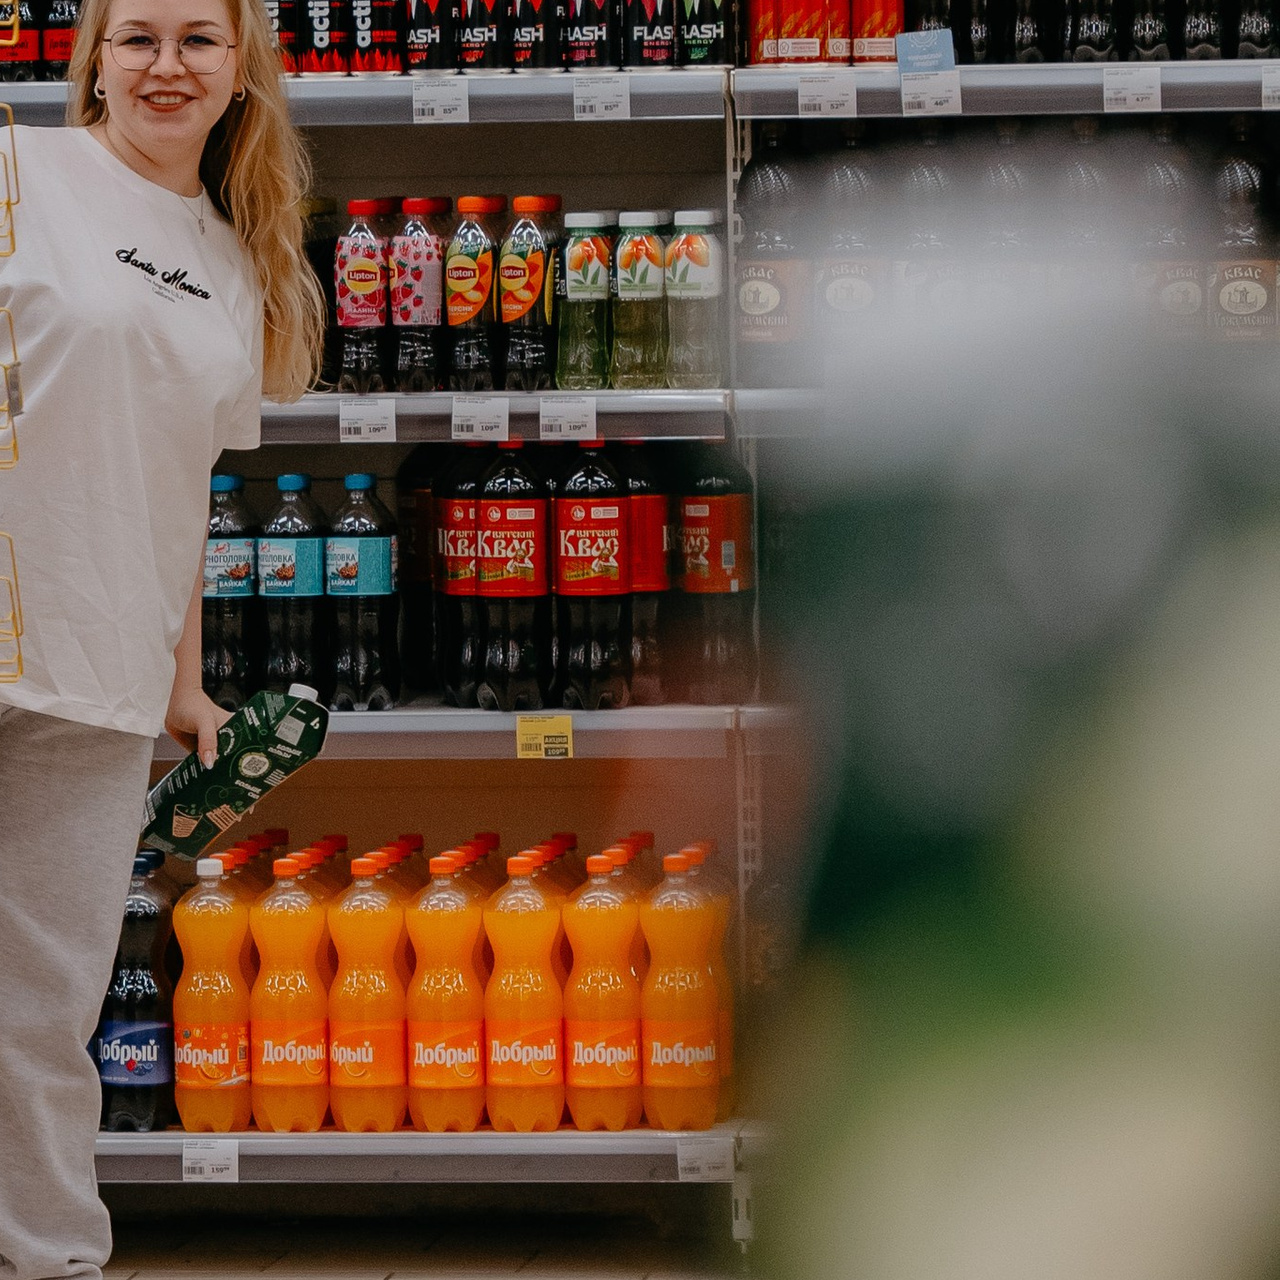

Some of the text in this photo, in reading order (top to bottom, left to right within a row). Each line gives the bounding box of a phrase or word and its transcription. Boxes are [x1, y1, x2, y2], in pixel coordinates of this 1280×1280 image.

[116, 248, 211, 300] Santa Monica
[349, 272, 376, 280] Lipton
[448, 269, 474, 277] Lipton
[501, 269, 524, 277] Lipton
[1225, 267, 1263, 280] КВАС
[219, 580, 247, 588] БАЙКАЛ
[266, 580, 293, 588] БАЙКАЛ
[175, 1042, 229, 1066] обрый
[331, 1041, 373, 1066] брый
[492, 1038, 557, 1066] Добрый
